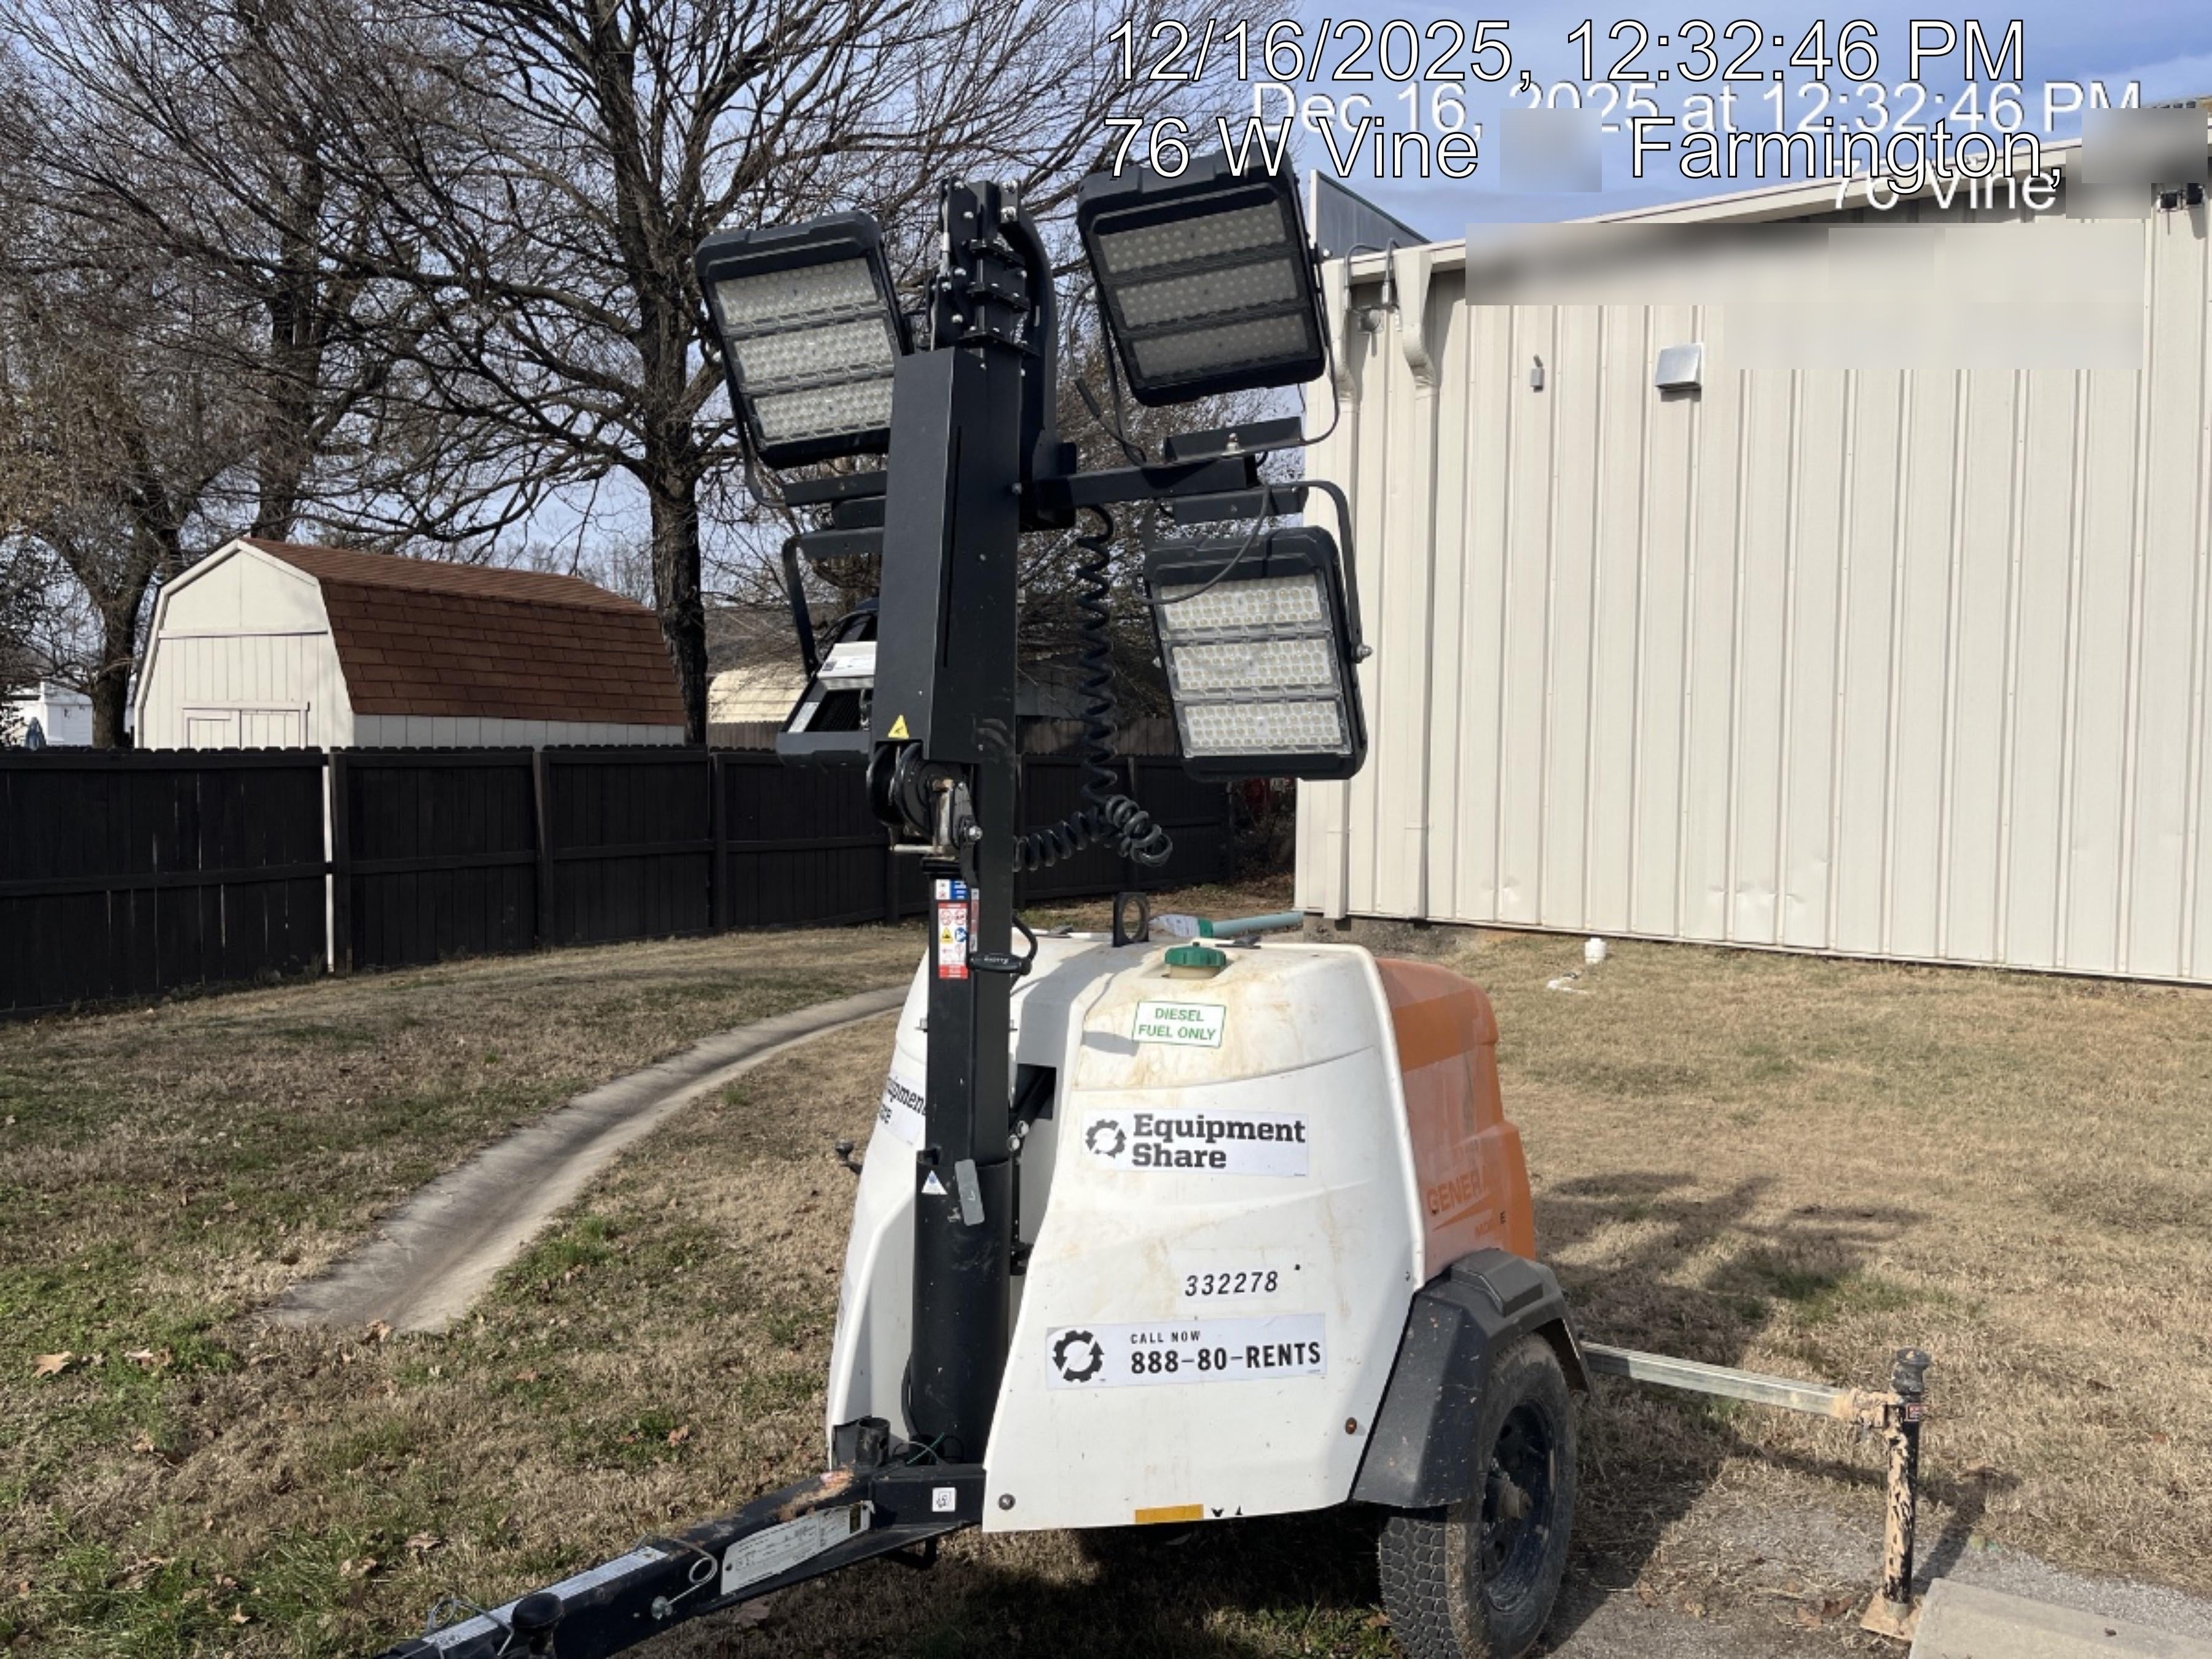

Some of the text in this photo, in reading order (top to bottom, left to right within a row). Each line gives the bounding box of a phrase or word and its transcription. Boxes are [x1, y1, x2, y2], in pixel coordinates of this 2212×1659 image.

[1155, 1008, 1204, 1022] DIESEL
[1139, 1024, 1216, 1040] FUEL ONLY
[1133, 1113, 1306, 1143] Equipment
[1131, 1142, 1228, 1169] Share
[1185, 1270, 1279, 1296] 332278
[1130, 1330, 1201, 1344] CALL NOW
[1131, 1341, 1321, 1374] 888-80-RENTS
